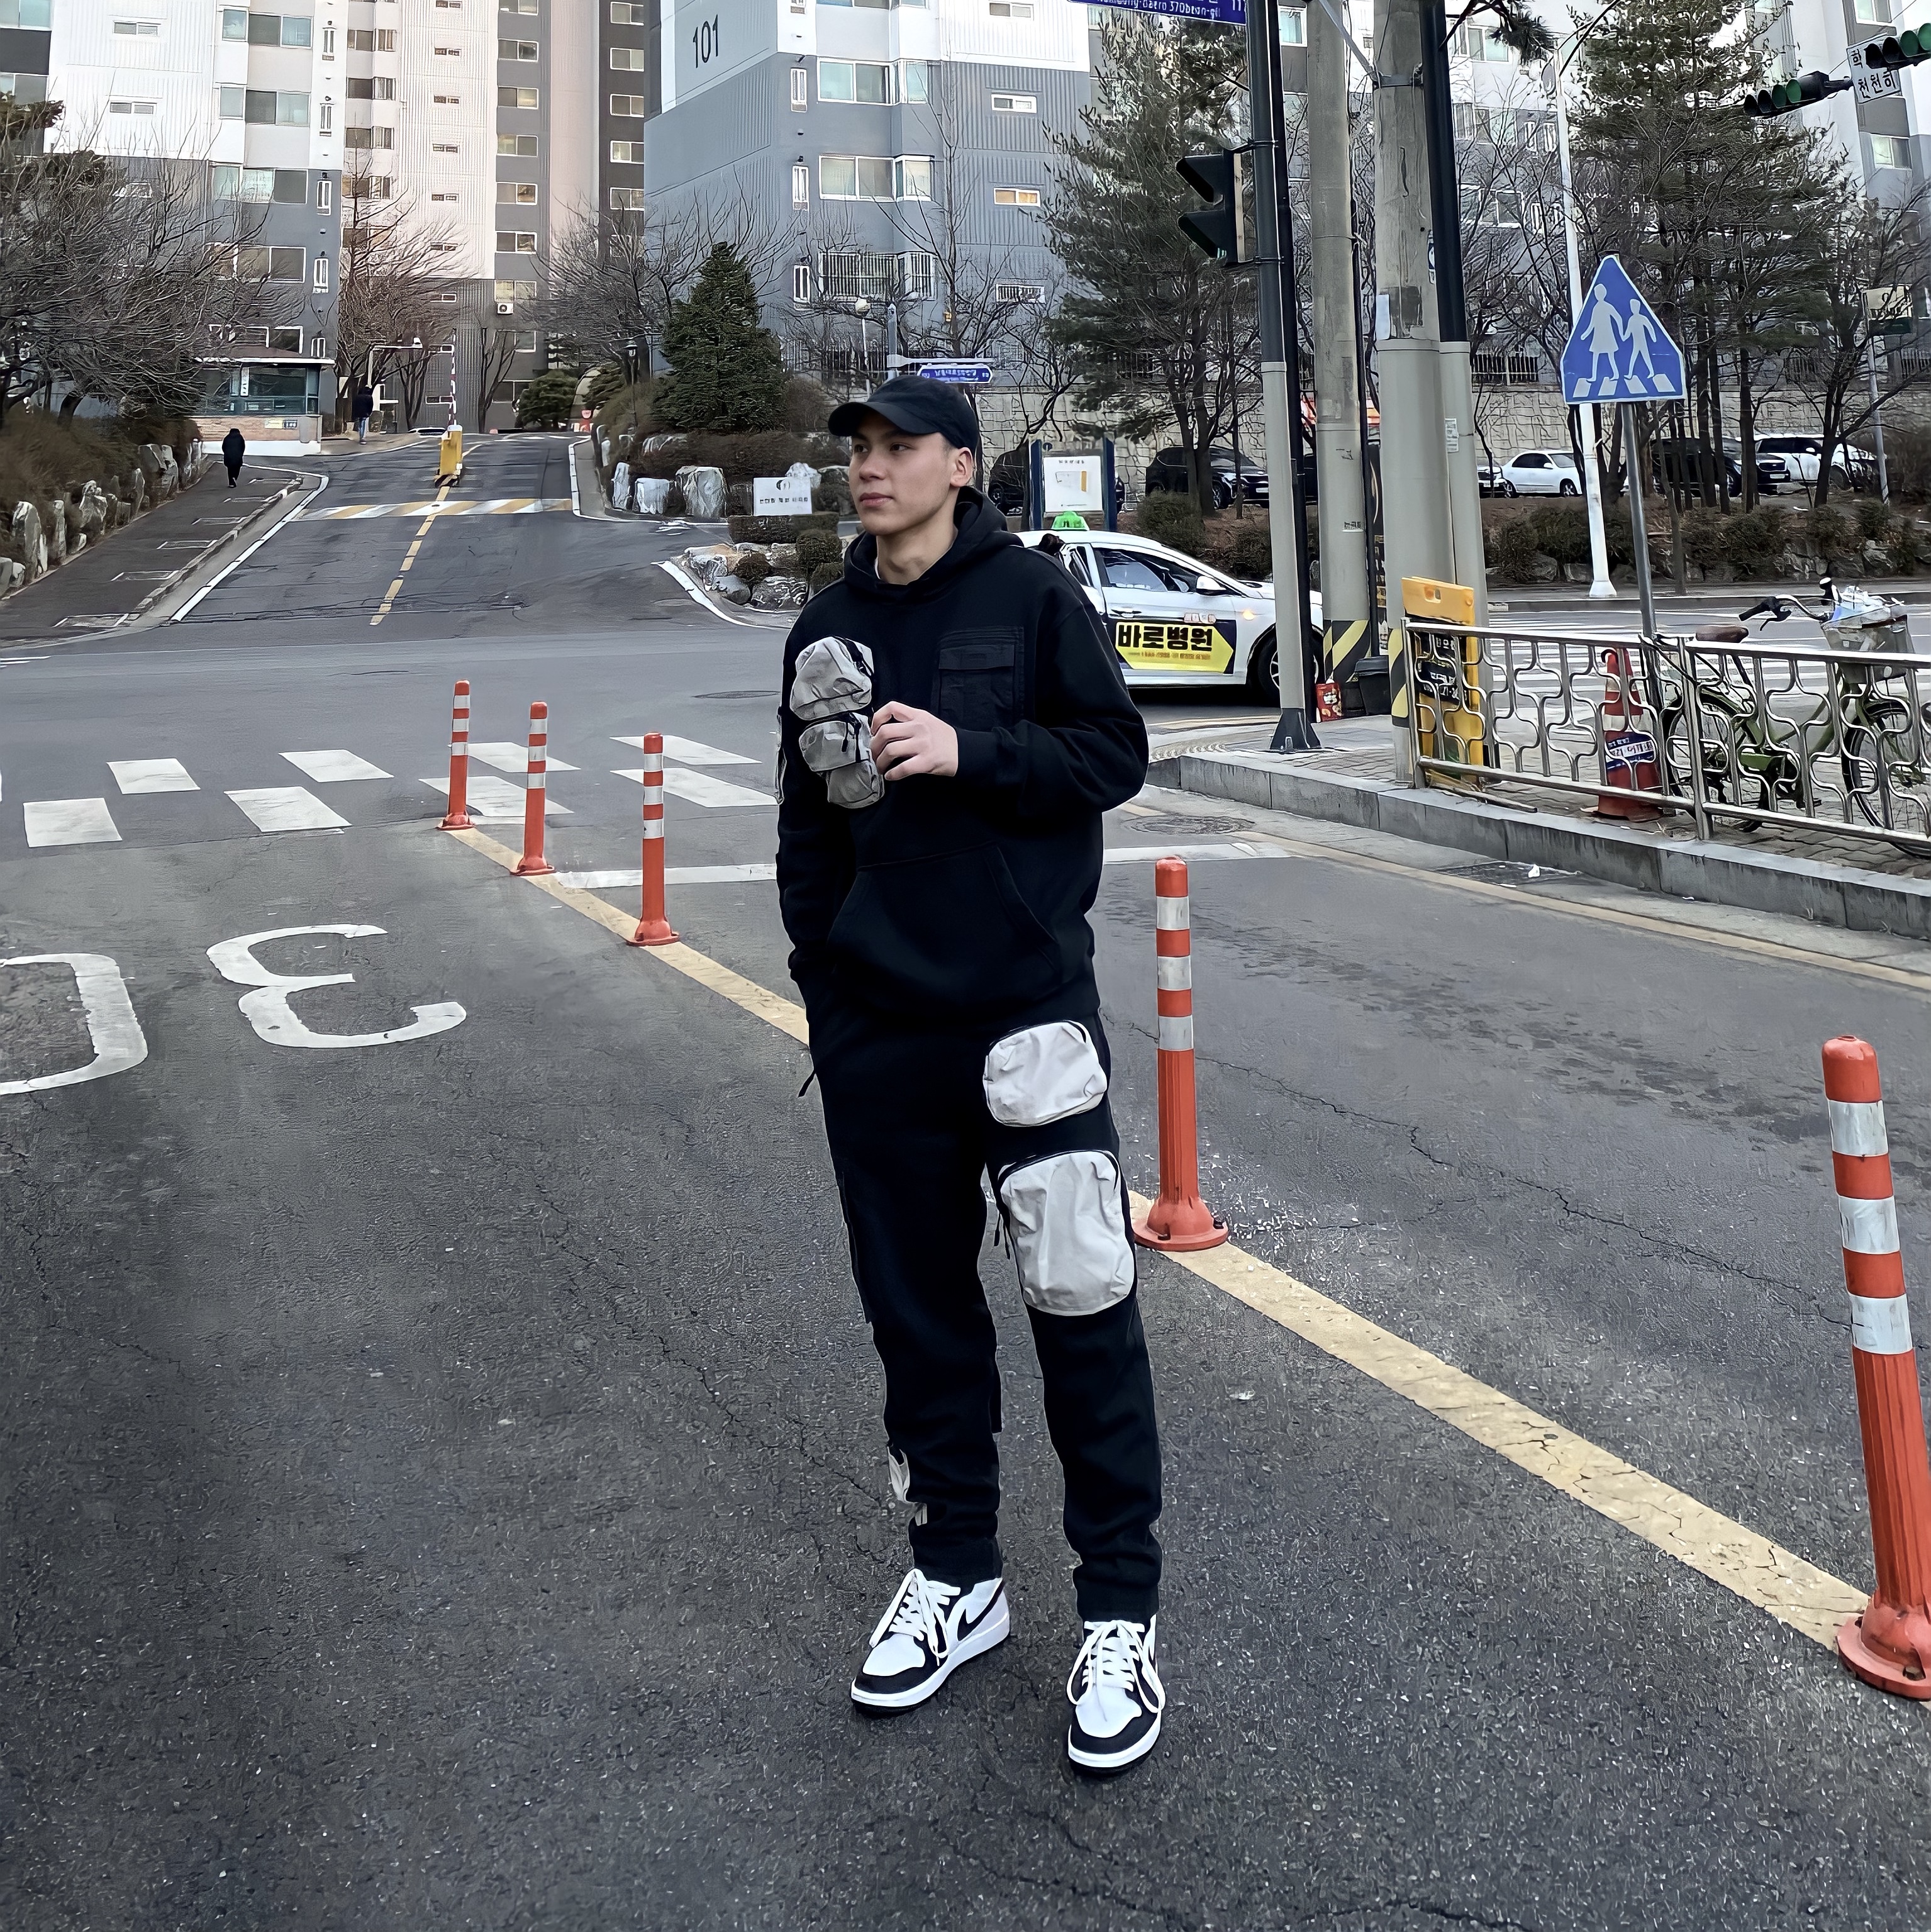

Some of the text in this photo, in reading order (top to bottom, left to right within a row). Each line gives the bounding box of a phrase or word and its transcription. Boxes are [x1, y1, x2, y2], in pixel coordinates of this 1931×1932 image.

[693, 14, 718, 68] 101
[1858, 71, 1896, 99] 천천히
[1118, 625, 1213, 652] 바로병원
